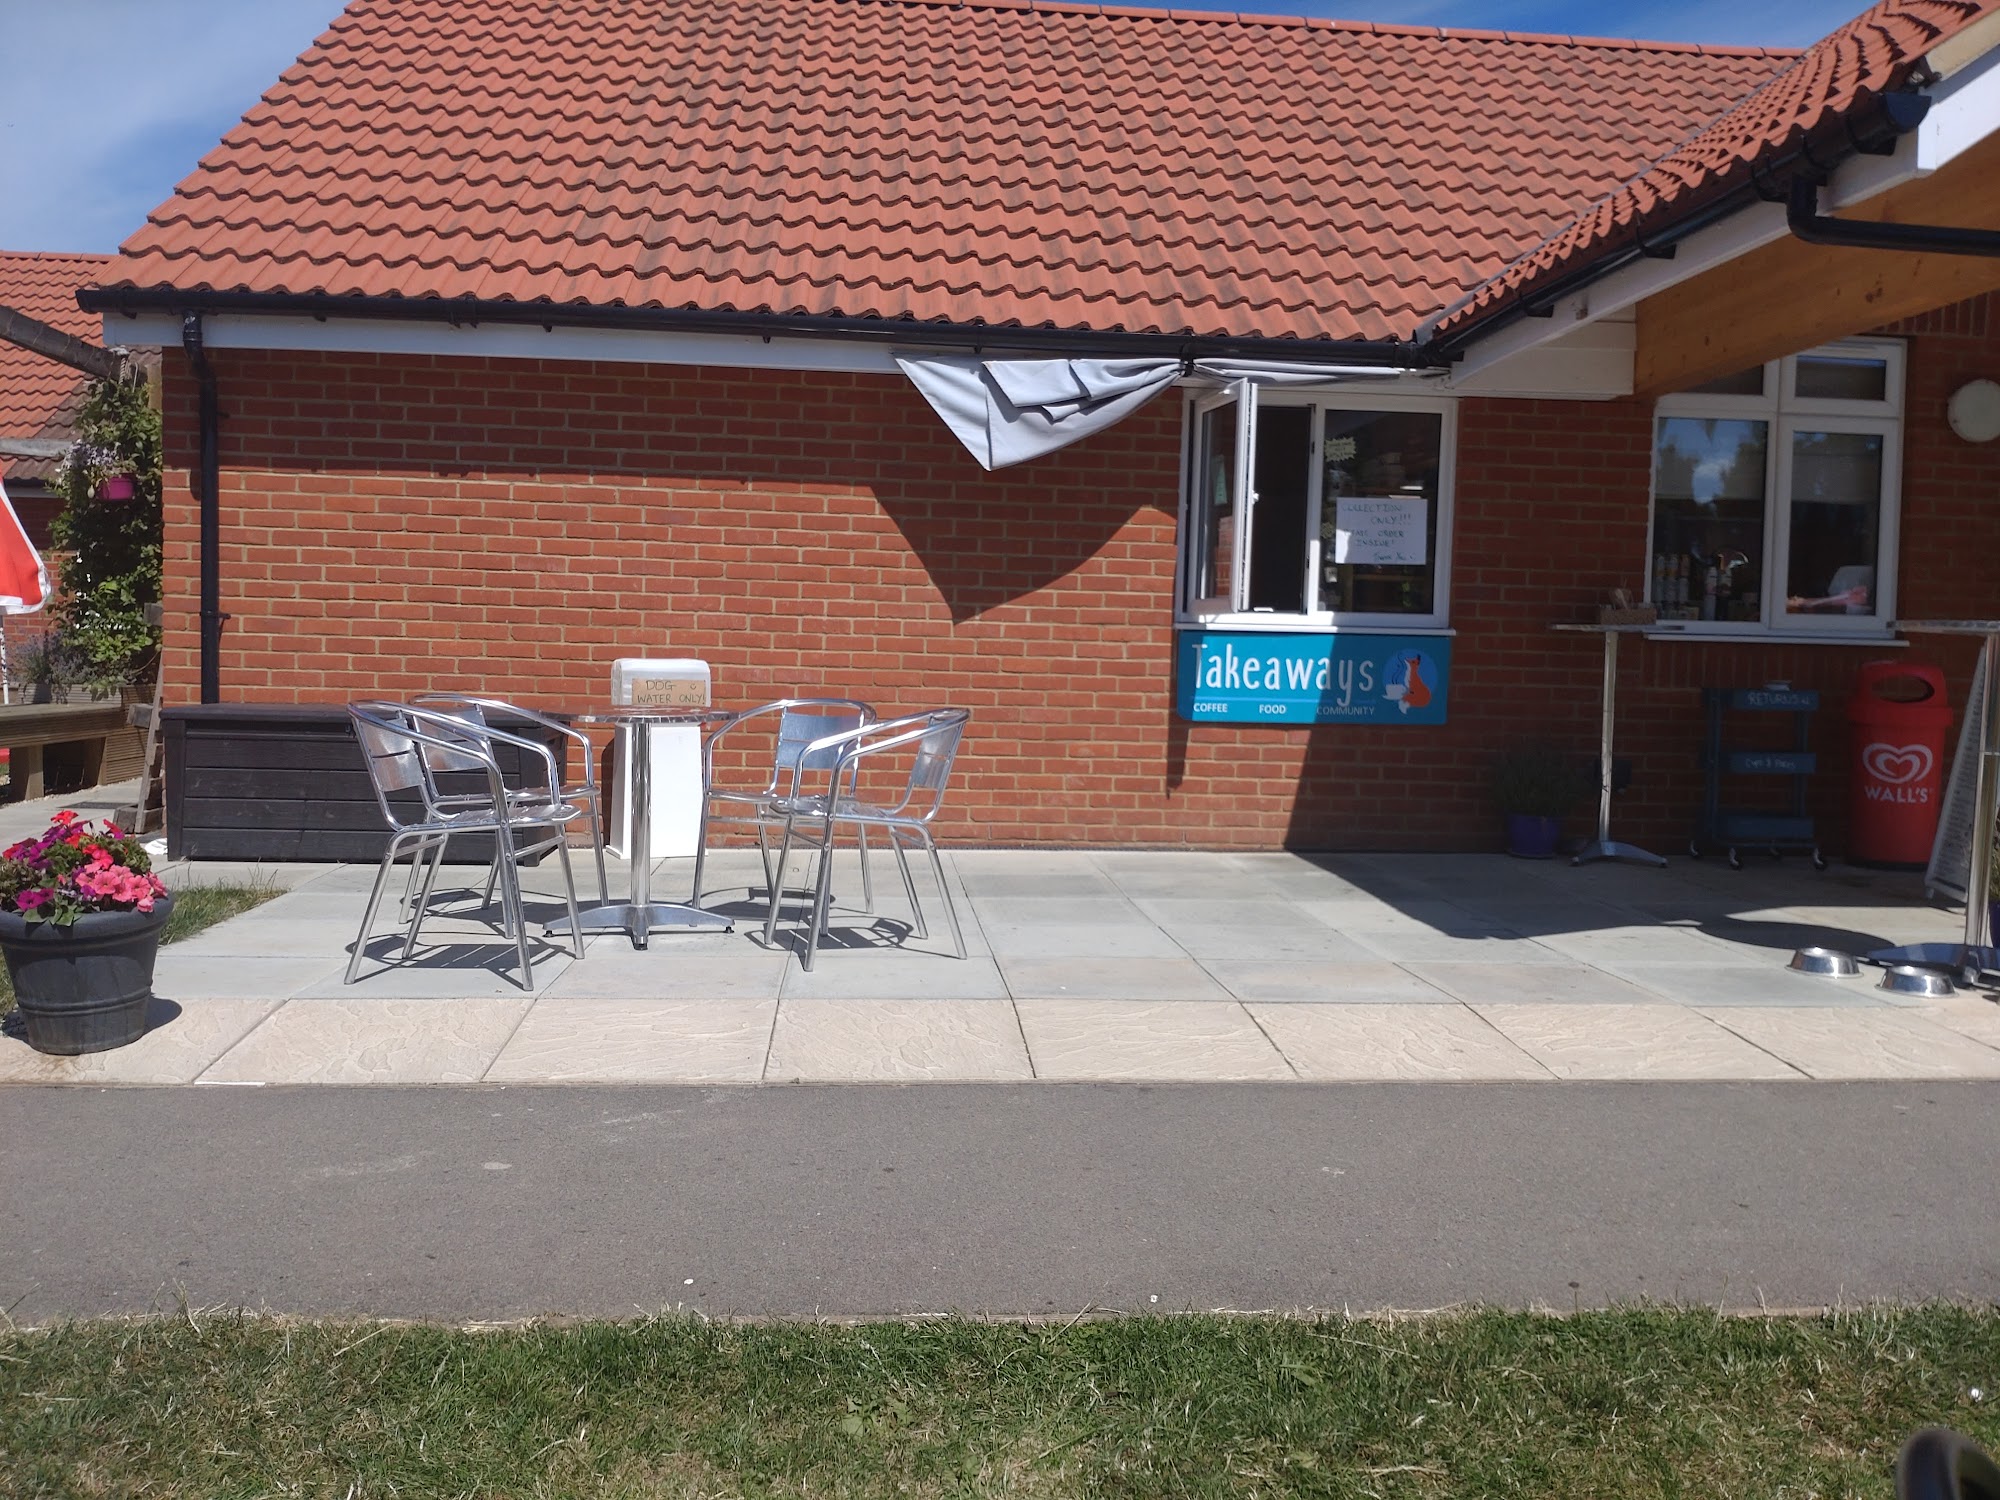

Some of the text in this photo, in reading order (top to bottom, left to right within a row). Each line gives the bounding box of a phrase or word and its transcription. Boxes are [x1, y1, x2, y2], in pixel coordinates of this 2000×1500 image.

[1192, 643, 1374, 706] Takeaways
[646, 680, 676, 691] DOG
[637, 693, 706, 705] WATER ONLY!
[1193, 703, 1375, 716] COFFEE FOOD COMMUNITY
[1863, 785, 1929, 803] WALL'S
